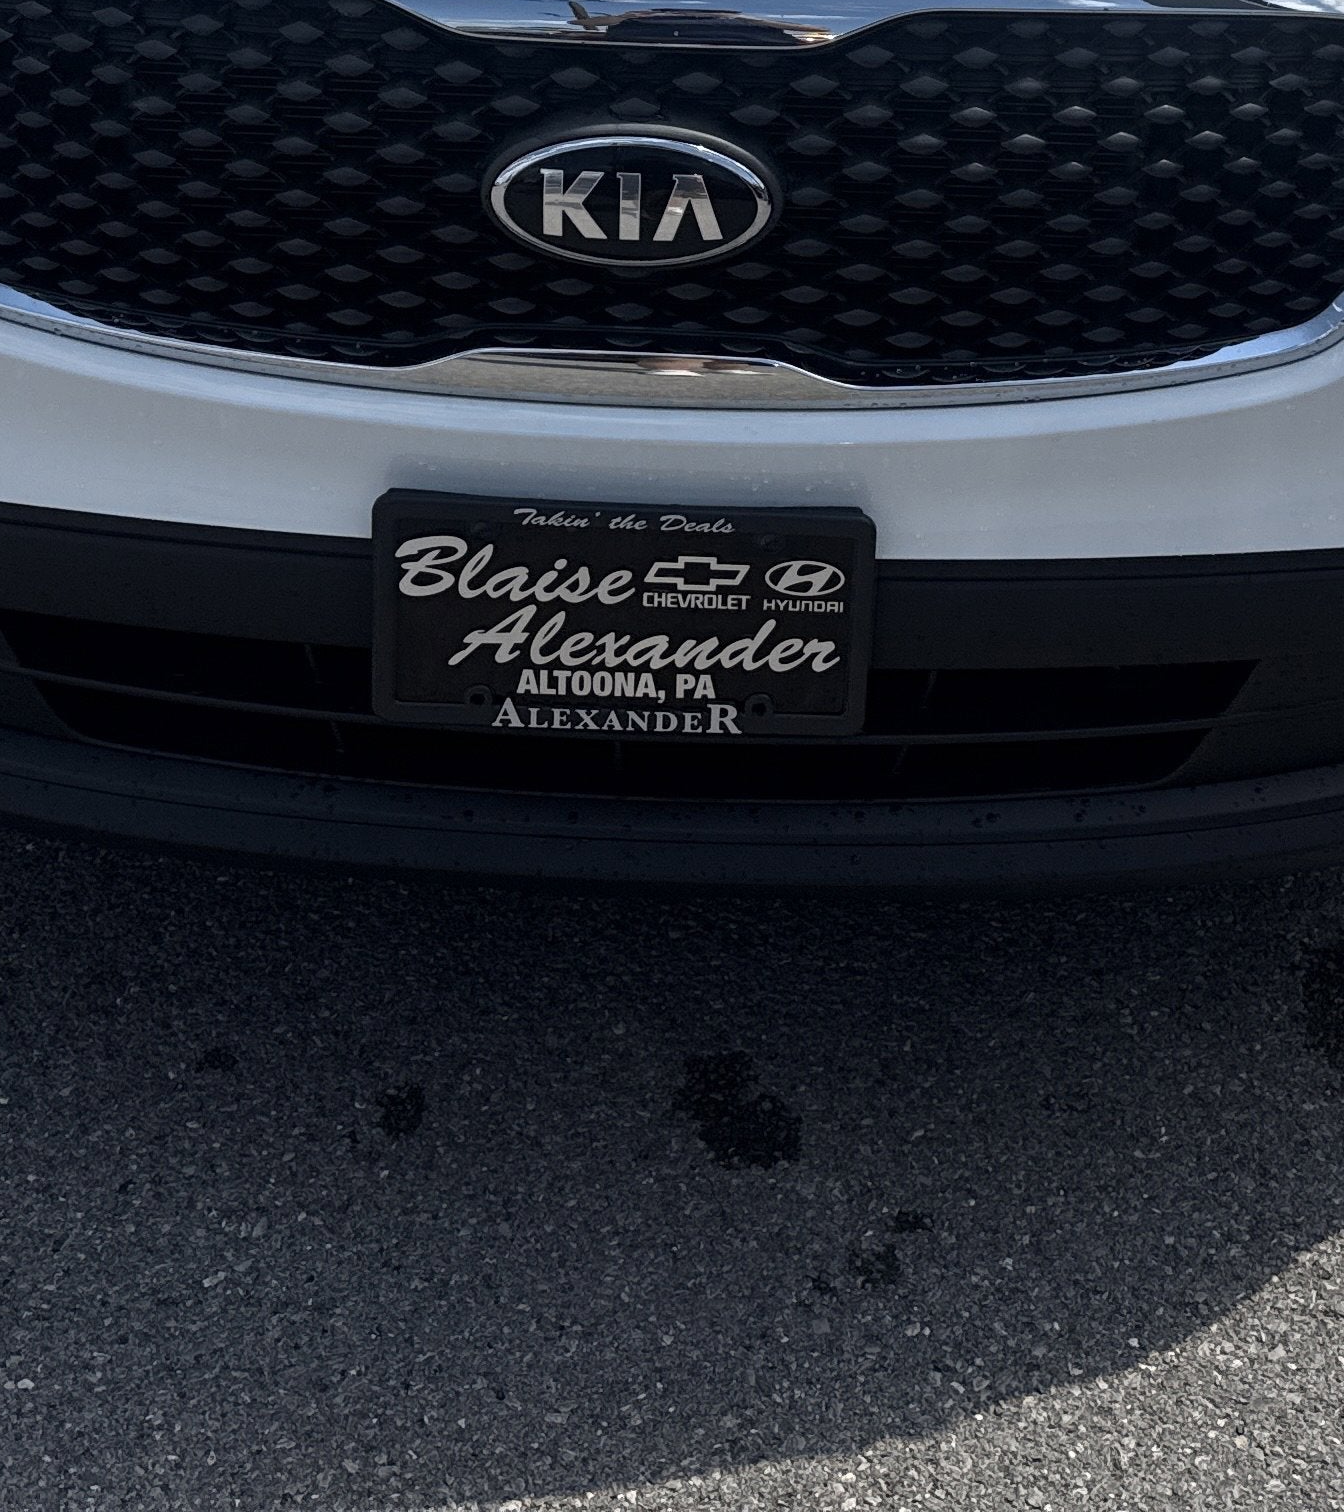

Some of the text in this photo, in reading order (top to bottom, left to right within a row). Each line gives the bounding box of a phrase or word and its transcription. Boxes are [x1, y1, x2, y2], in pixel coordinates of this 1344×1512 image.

[539, 168, 724, 242] KIA
[513, 507, 736, 535] Takin' the Deals
[394, 534, 637, 606] Blaise
[642, 592, 845, 614] CHEVROLET HYUNDAI
[447, 604, 841, 674] Alexander
[516, 668, 716, 705] ALTOONA, PA
